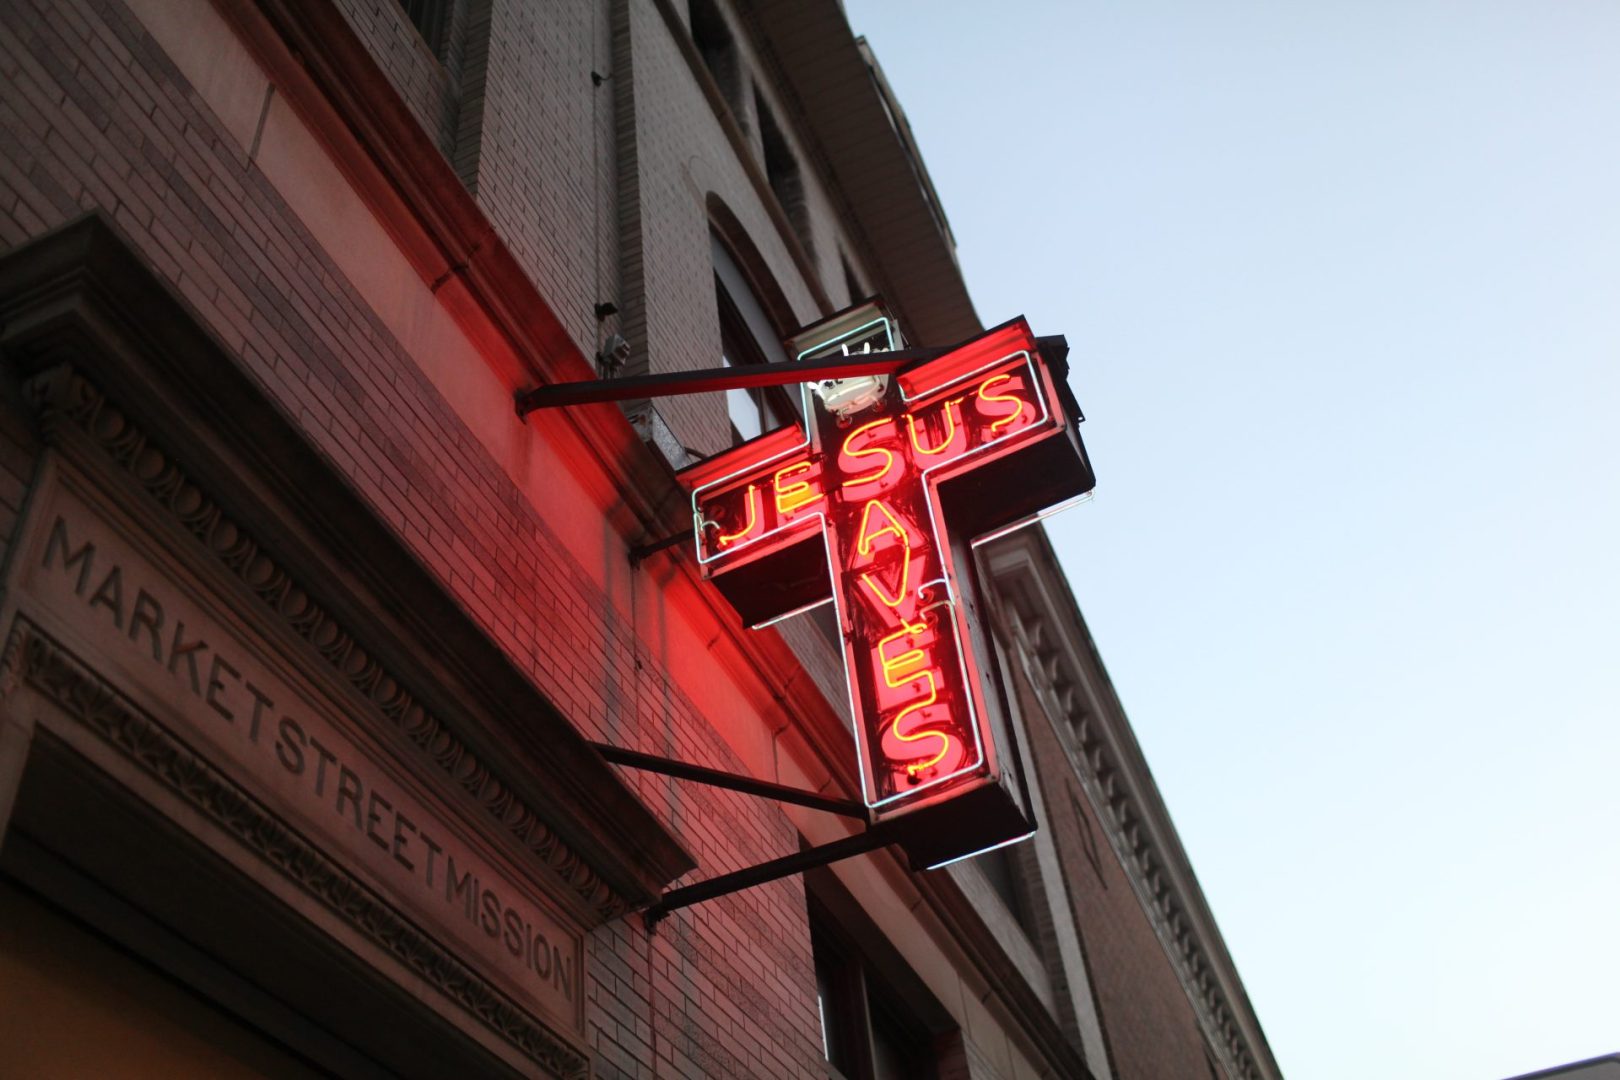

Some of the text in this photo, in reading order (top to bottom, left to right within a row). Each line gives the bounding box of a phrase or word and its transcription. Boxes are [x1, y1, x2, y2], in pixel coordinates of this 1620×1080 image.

[719, 374, 1035, 547] JESUS
[42, 515, 574, 1001] MARKET STREET MISSION
